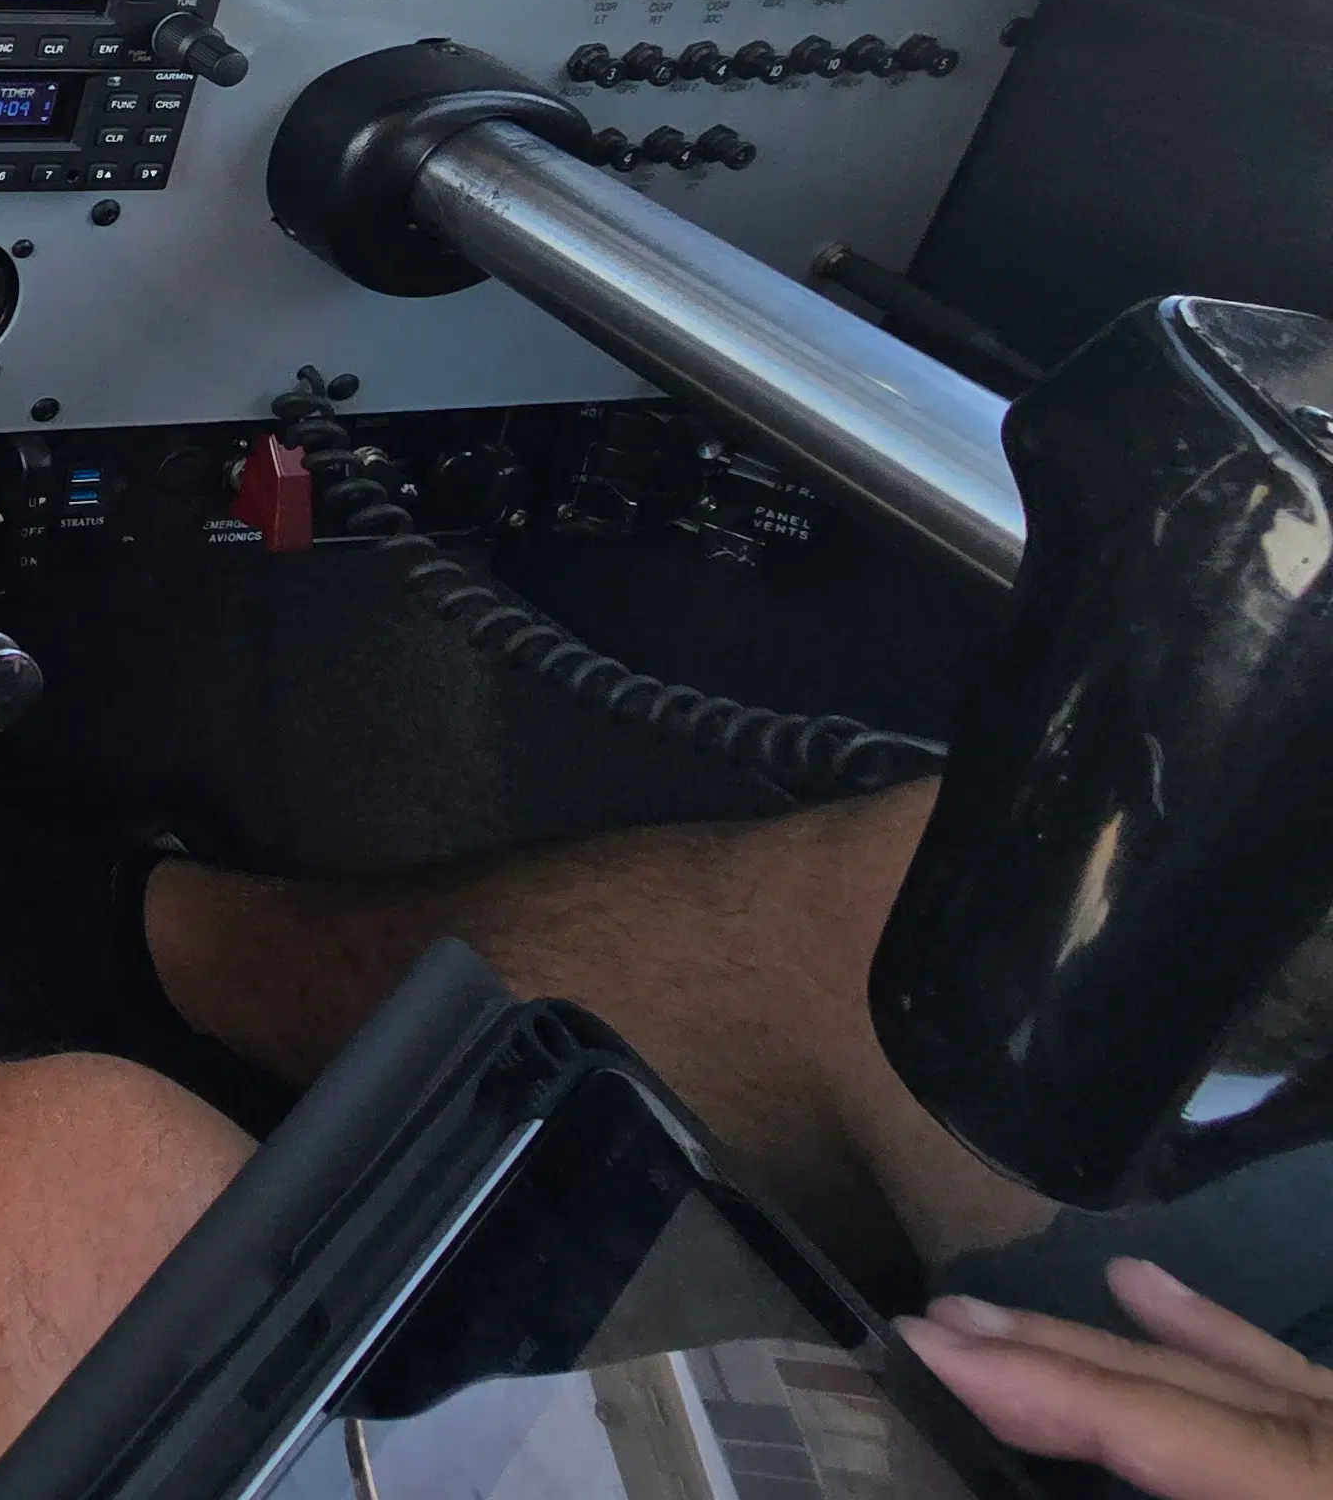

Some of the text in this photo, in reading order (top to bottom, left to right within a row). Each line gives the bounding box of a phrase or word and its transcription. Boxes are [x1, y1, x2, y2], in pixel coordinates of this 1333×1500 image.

[44, 44, 64, 55] CLR
[99, 45, 119, 55] ENT
[0, 88, 35, 98] TIMER
[60, 517, 105, 528] STRATUS
